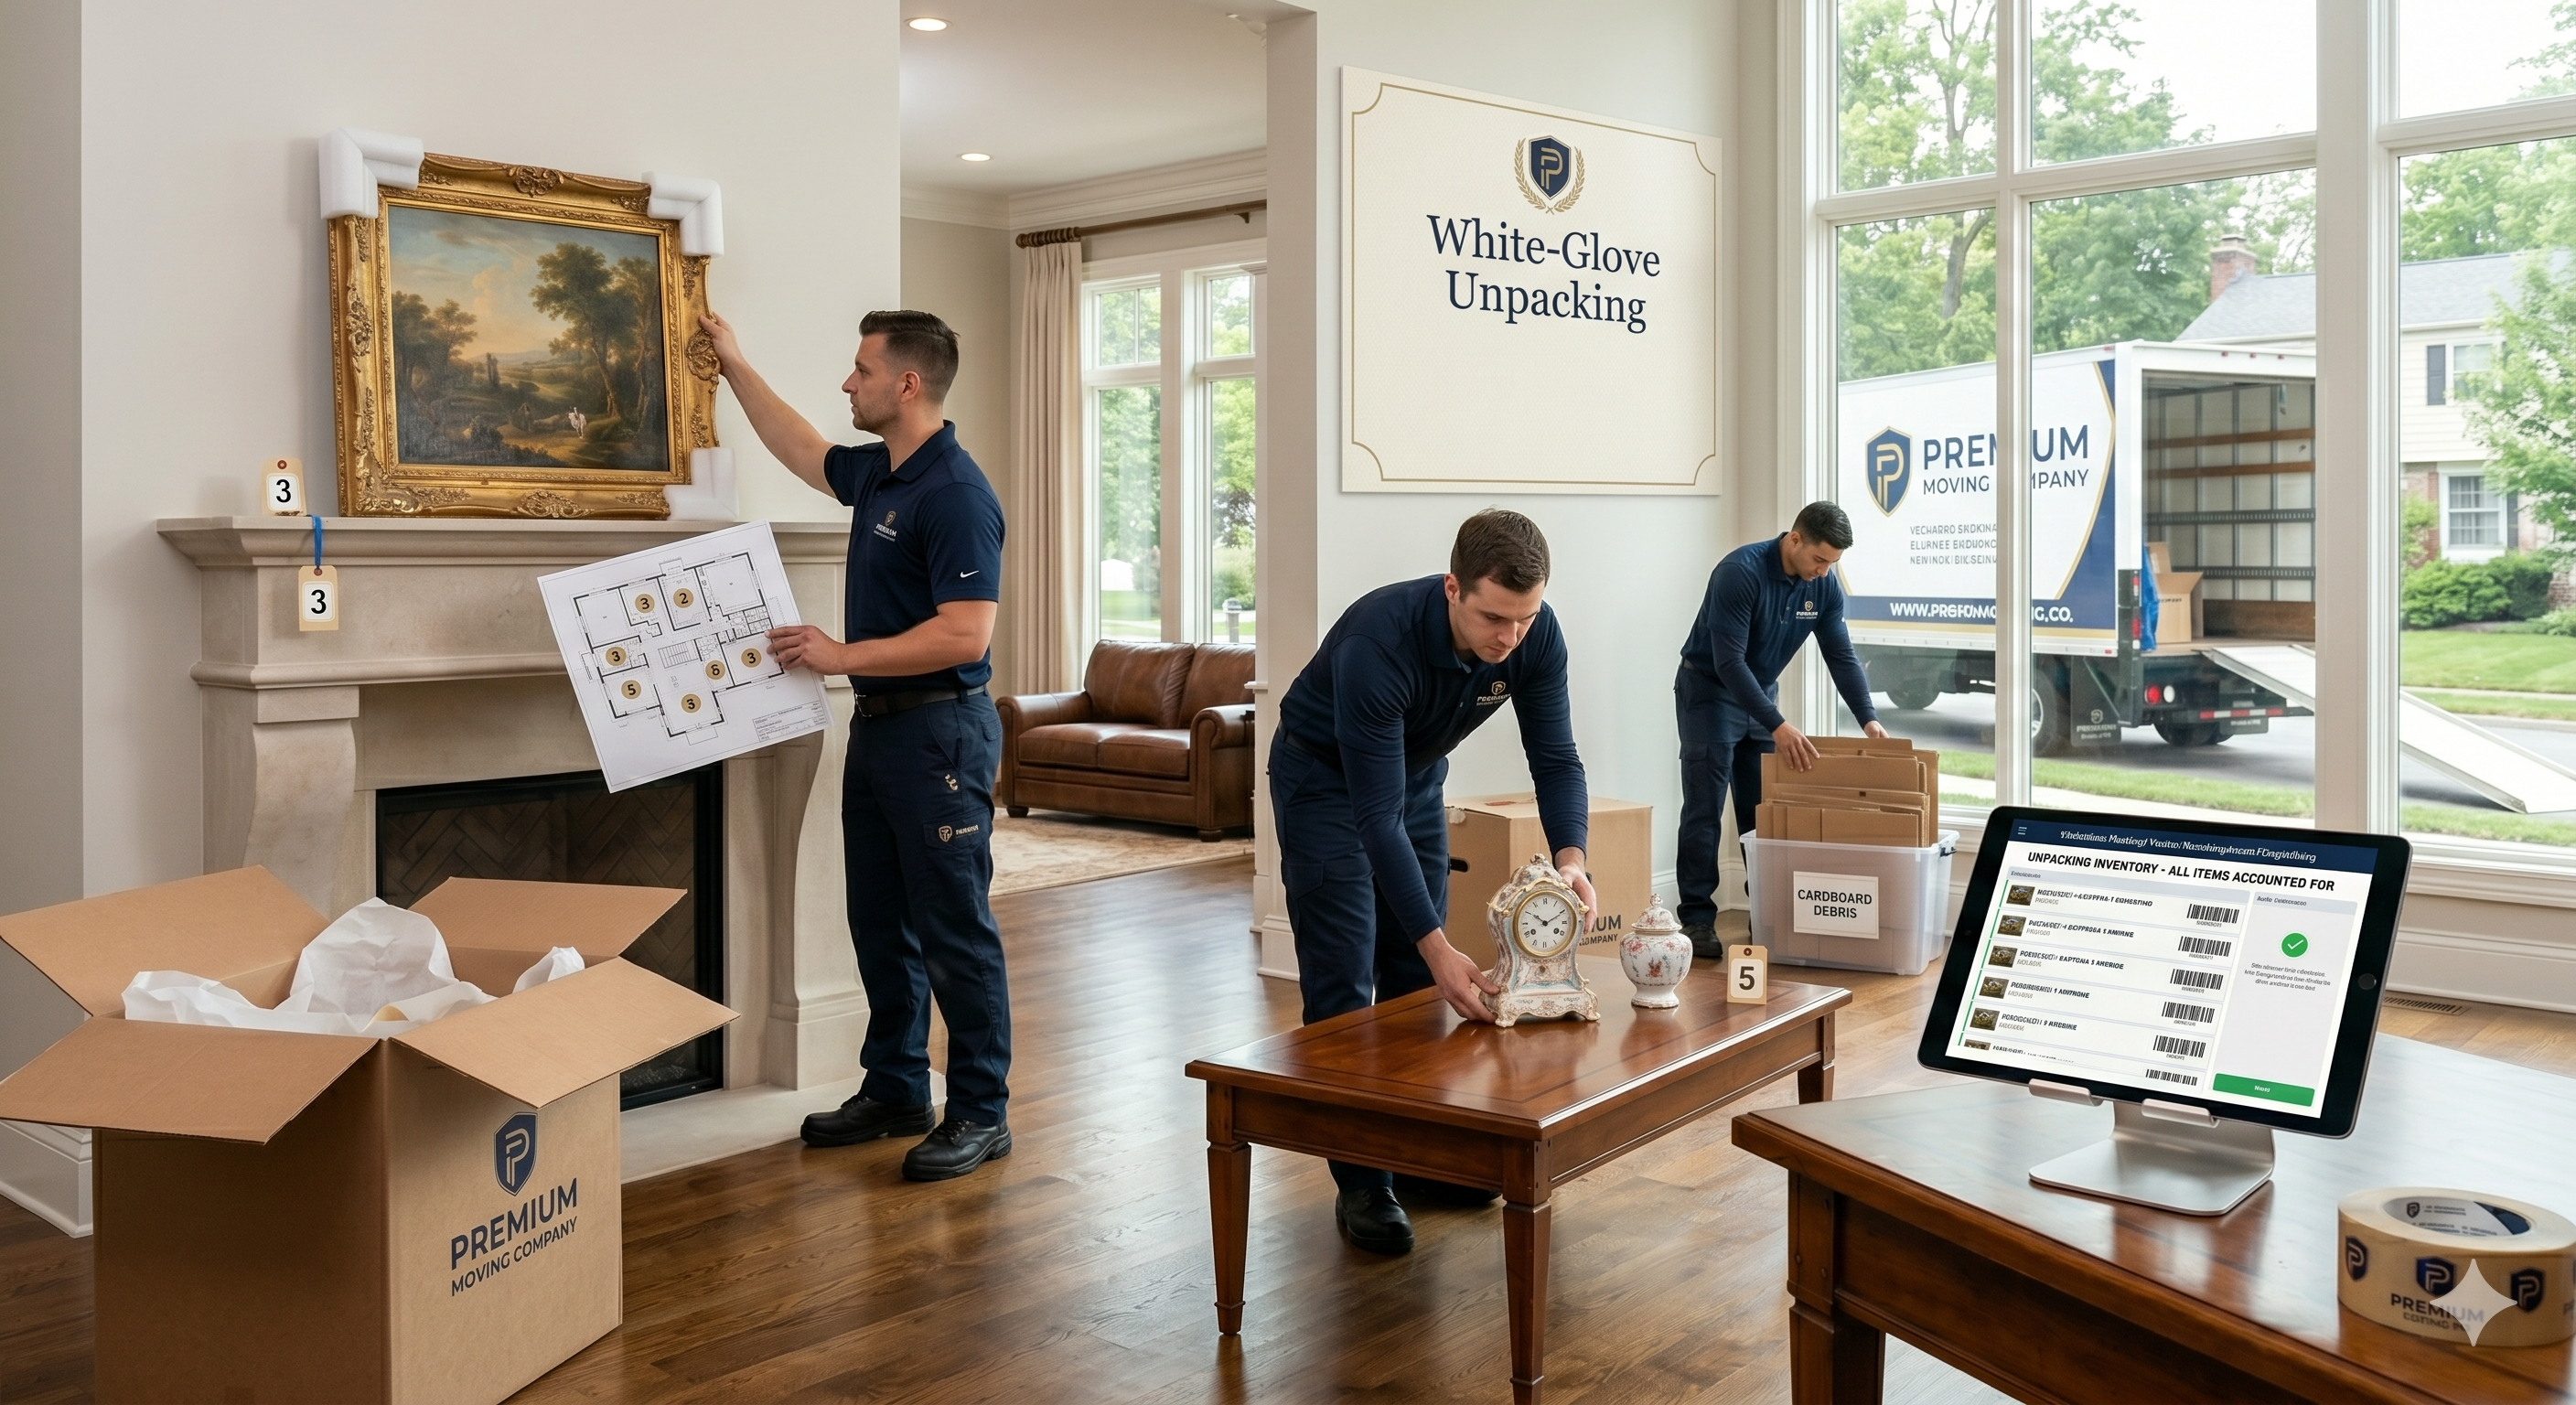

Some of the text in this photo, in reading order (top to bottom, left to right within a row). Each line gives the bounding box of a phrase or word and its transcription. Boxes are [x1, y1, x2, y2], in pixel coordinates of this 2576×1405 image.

[1426, 214, 1660, 277] White-Glove
[1445, 269, 1647, 334] Unpacking
[275, 478, 292, 503] 3
[1923, 475, 1990, 495] MOVING
[310, 588, 327, 615] 3
[640, 597, 650, 609] 3
[679, 592, 689, 604] 2
[611, 650, 621, 662] 3
[746, 652, 757, 664] 3
[627, 683, 637, 695] 5
[2027, 852, 2092, 868] UNPACKING
[2093, 858, 2159, 874] INVENTORY
[2168, 865, 2190, 877] ALL
[2193, 867, 2230, 882] ITEMS
[2232, 871, 2307, 889] ACCOUNTED
[2309, 878, 2335, 892] FOR
[1798, 889, 1873, 905] CARDBOARD
[1813, 905, 1857, 918] DEBRIS
[1738, 965, 1755, 991] 5
[451, 1177, 577, 1271] PREMIUM
[451, 1216, 577, 1297] MOVING COMPANY
